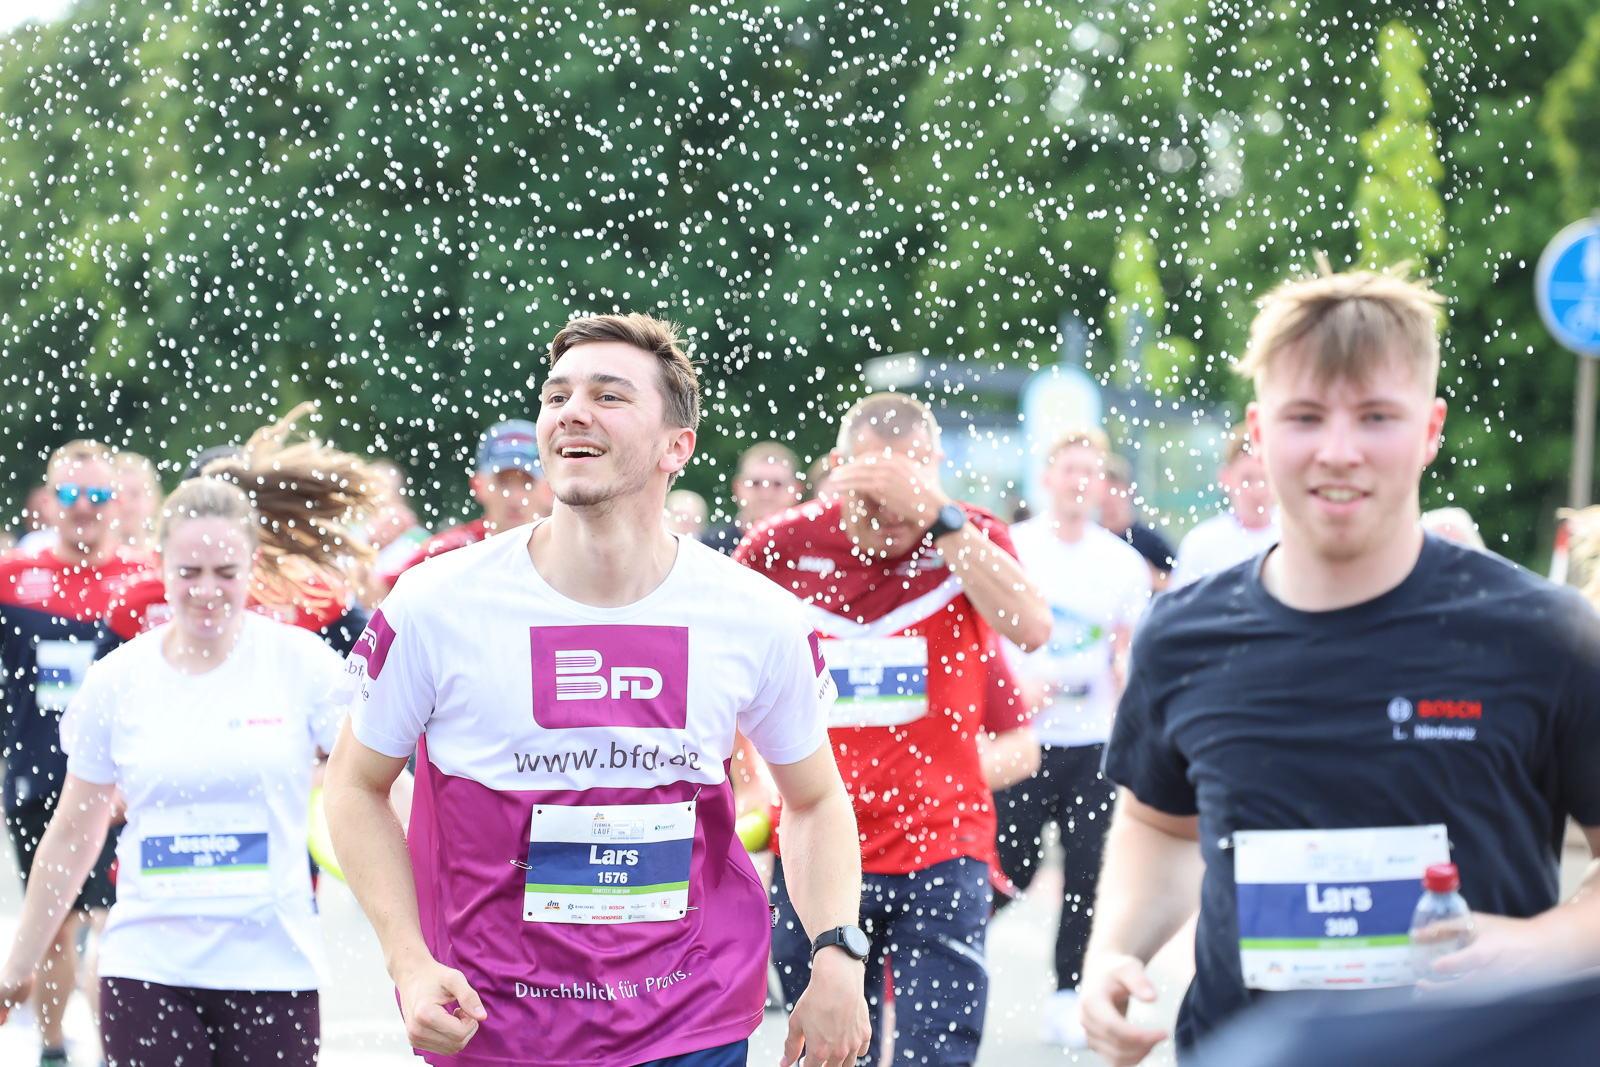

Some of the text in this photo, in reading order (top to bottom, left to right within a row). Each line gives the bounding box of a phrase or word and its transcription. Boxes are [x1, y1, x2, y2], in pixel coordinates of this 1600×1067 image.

[555, 649, 664, 700] BFD
[1417, 699, 1482, 719] BOSCH
[513, 741, 702, 773] www.bfd.de
[589, 844, 639, 866] Lars
[597, 871, 628, 884] 1576
[1305, 883, 1373, 913] Lars
[515, 982, 618, 1001] Durchblick
[618, 980, 639, 999] für
